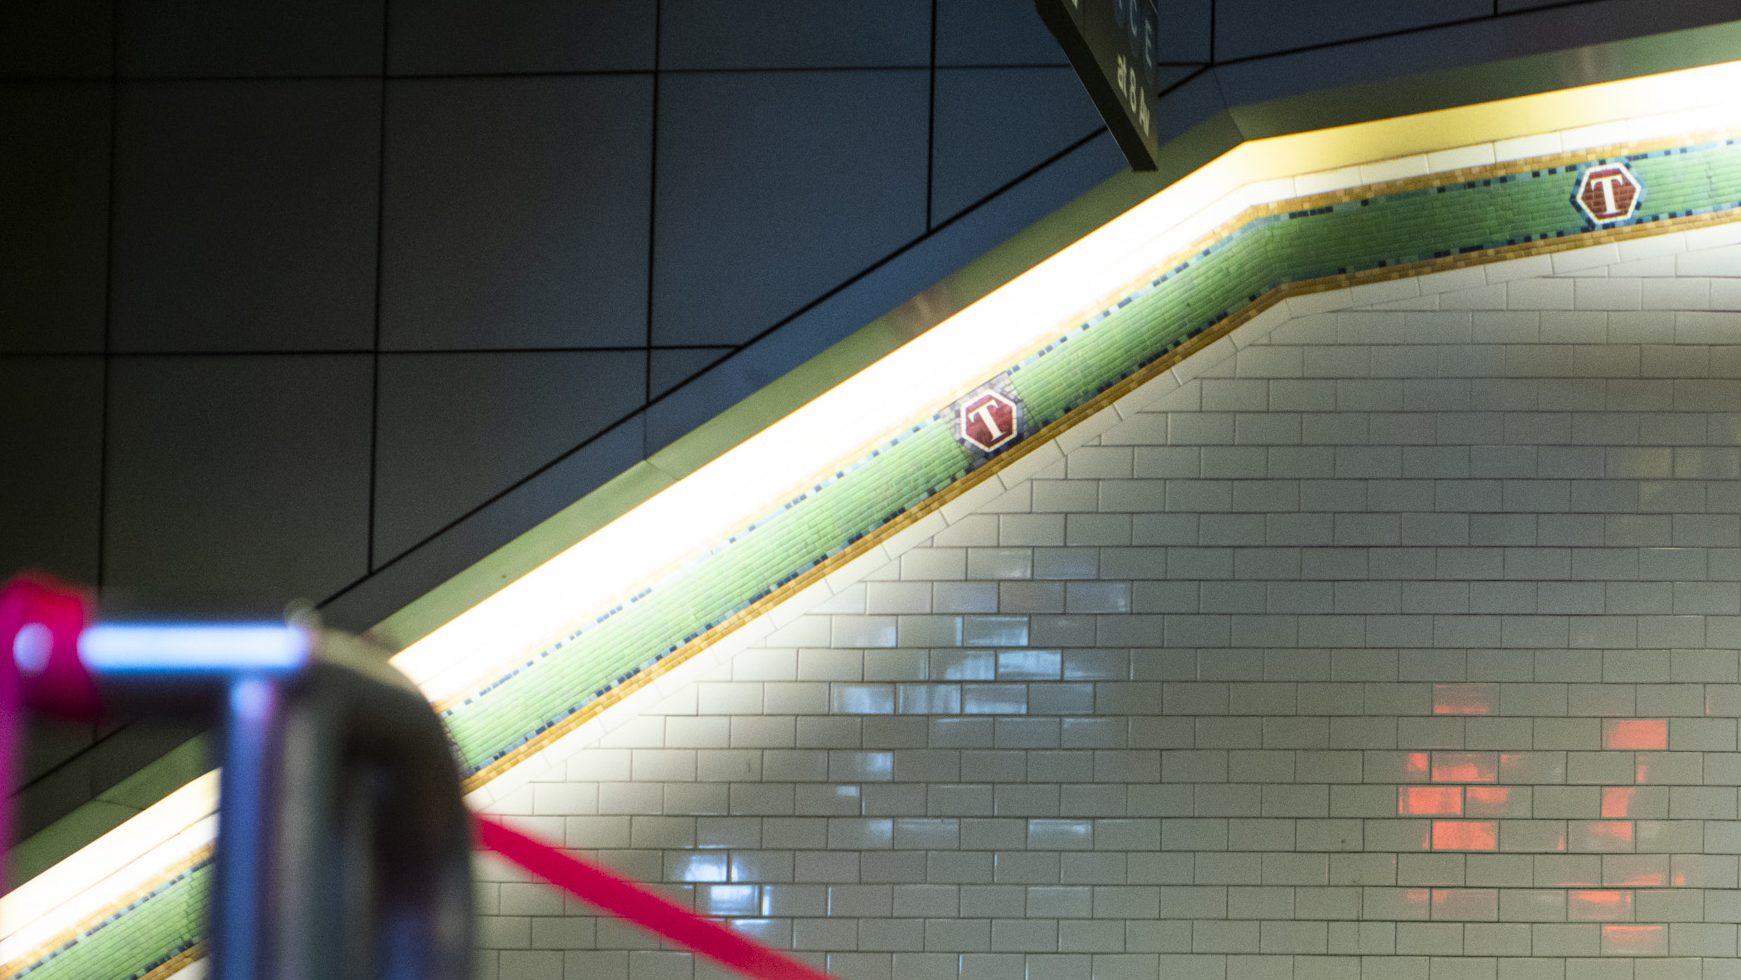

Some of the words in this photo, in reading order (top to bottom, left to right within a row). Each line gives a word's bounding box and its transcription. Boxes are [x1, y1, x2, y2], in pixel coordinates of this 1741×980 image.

[1129, 67, 1137, 114] 8
[1590, 173, 1623, 215] T
[967, 397, 1009, 442] T
